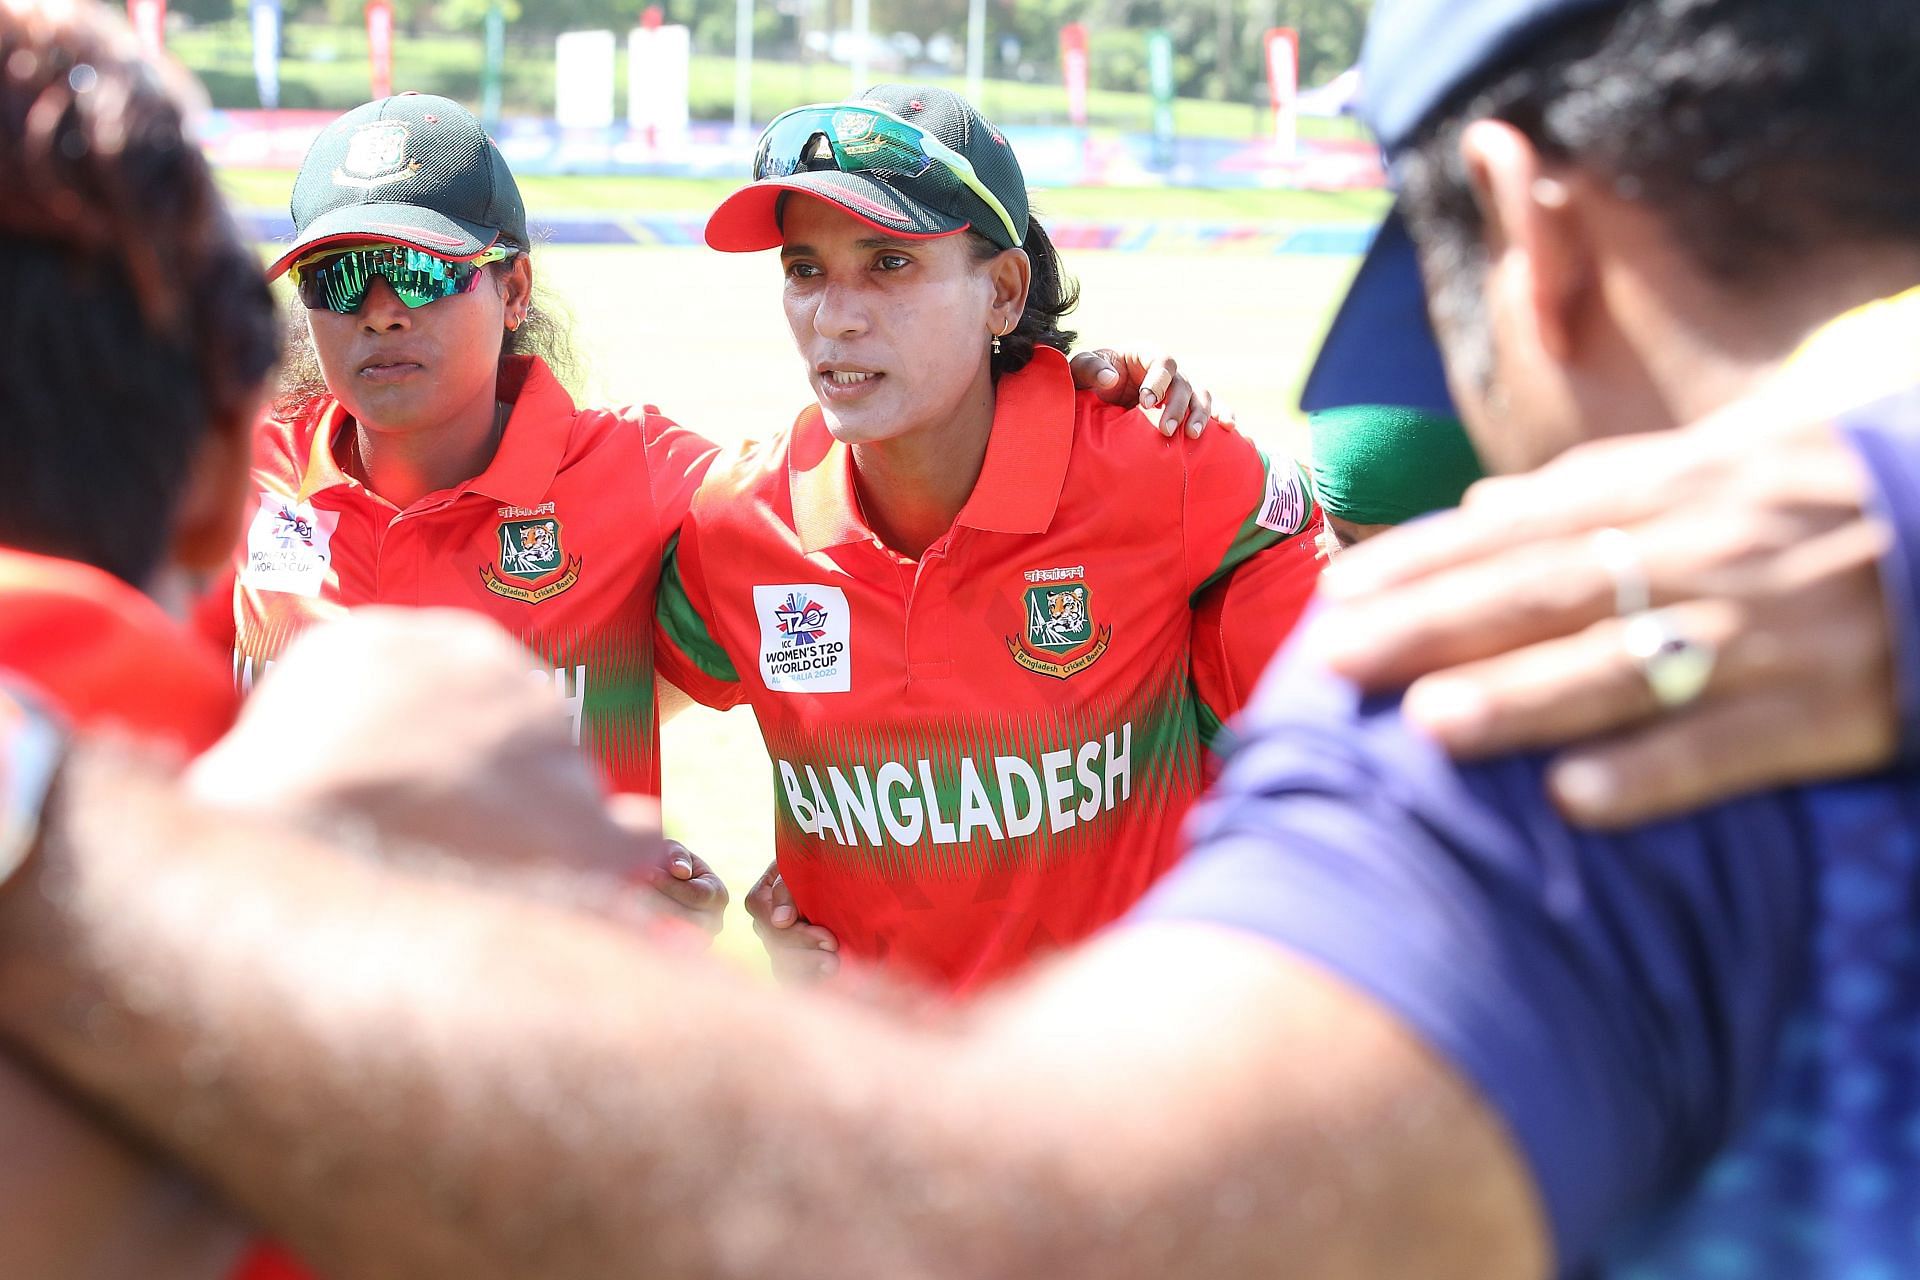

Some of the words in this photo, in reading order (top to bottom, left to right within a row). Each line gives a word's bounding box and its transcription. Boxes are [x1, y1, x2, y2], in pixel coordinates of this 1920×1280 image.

[1024, 566, 1084, 582] বাংলাদেশ
[490, 580, 528, 597] Bangladesh
[533, 587, 555, 599] Cricket
[556, 575, 575, 588] Board
[781, 640, 792, 649] ICC
[766, 647, 817, 663] WOMEN'S
[1018, 653, 1058, 672] Bangladesh
[1062, 659, 1085, 673] Cricket
[1085, 644, 1103, 661] Board
[771, 660, 811, 675] WORLD
[812, 655, 838, 669] CUP
[814, 668, 837, 679] 2020
[778, 721, 1132, 847] BANGLADESH
